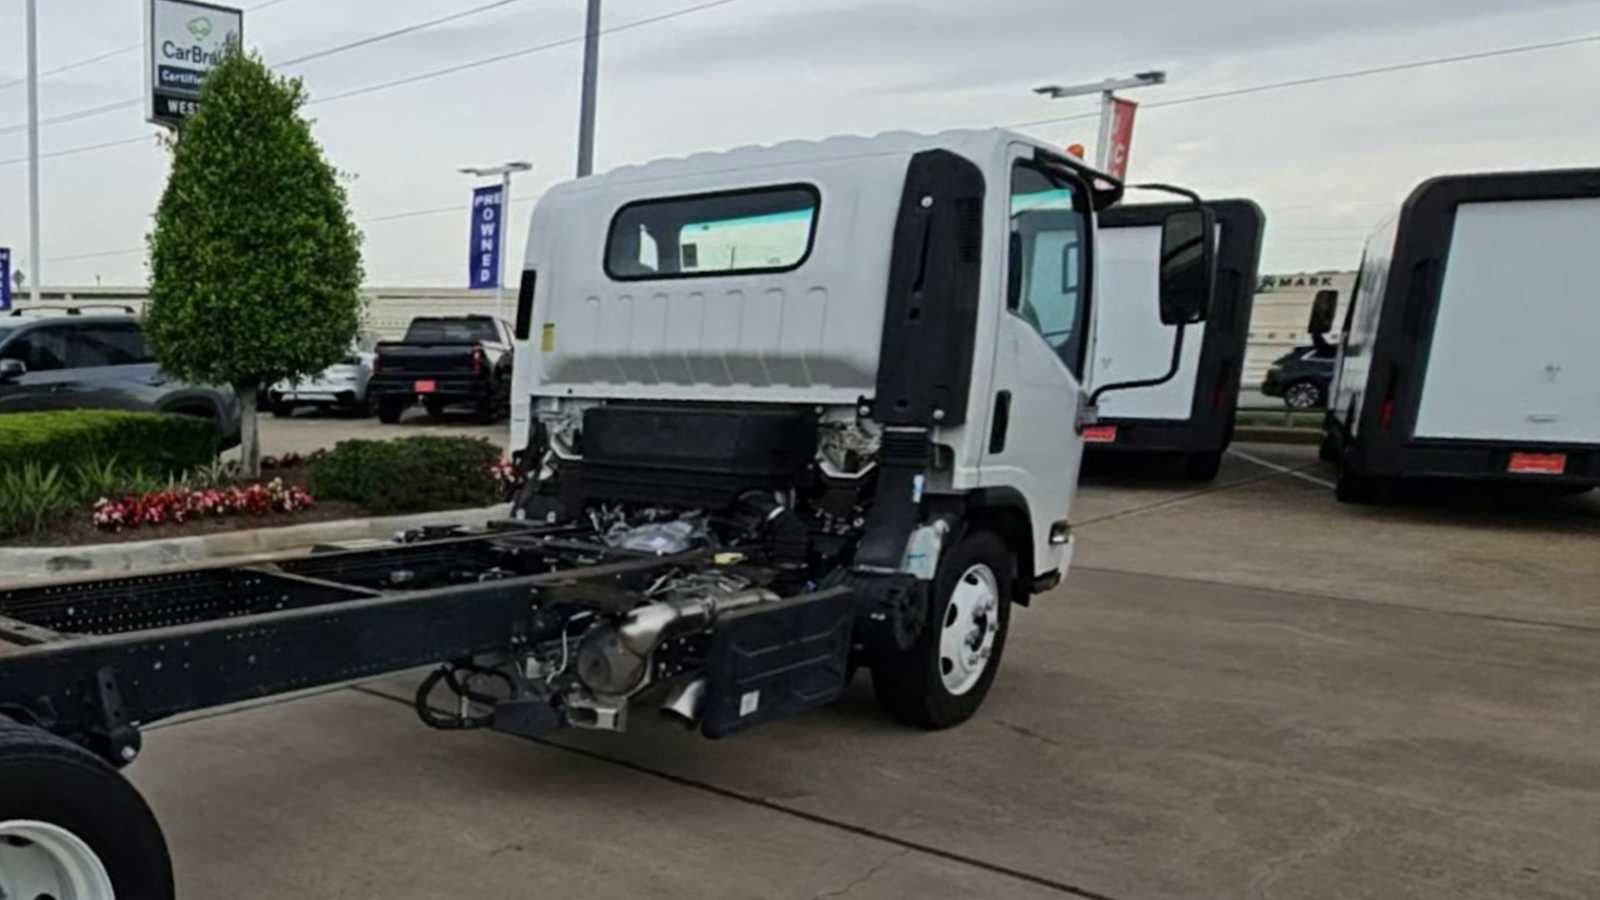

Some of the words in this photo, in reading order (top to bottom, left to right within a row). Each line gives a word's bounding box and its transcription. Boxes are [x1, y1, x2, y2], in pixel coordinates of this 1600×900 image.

[162, 40, 222, 65] CarBra
[475, 192, 502, 207] PRE
[480, 207, 496, 283] OWNED
